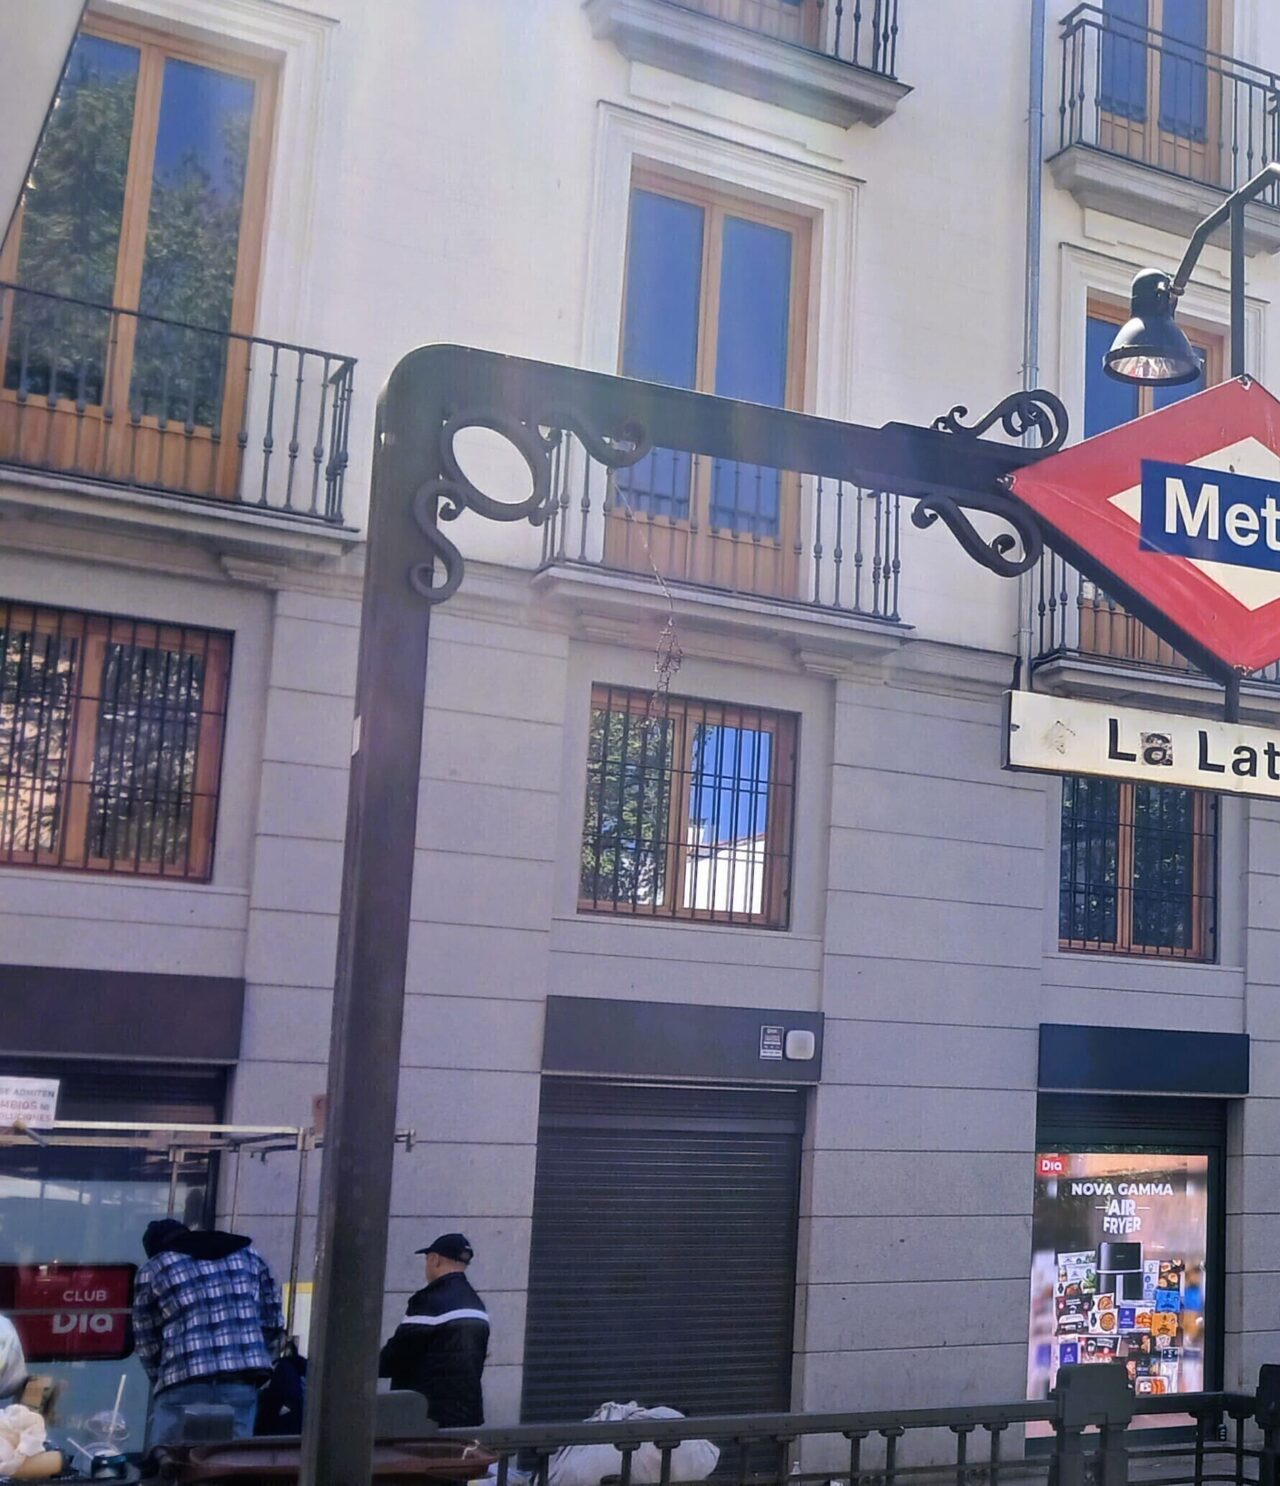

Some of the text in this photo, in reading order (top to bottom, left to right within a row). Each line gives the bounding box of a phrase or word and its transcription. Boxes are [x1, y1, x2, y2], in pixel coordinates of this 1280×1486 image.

[1108, 718, 1173, 765] La
[1041, 1159, 1062, 1171] Dia
[1071, 1182, 1174, 1196] NOVA GAMMA
[1108, 1199, 1136, 1216] AIR
[1103, 1216, 1142, 1234] FRYER
[63, 1290, 107, 1302] CLUB
[52, 1313, 113, 1334] Dia
